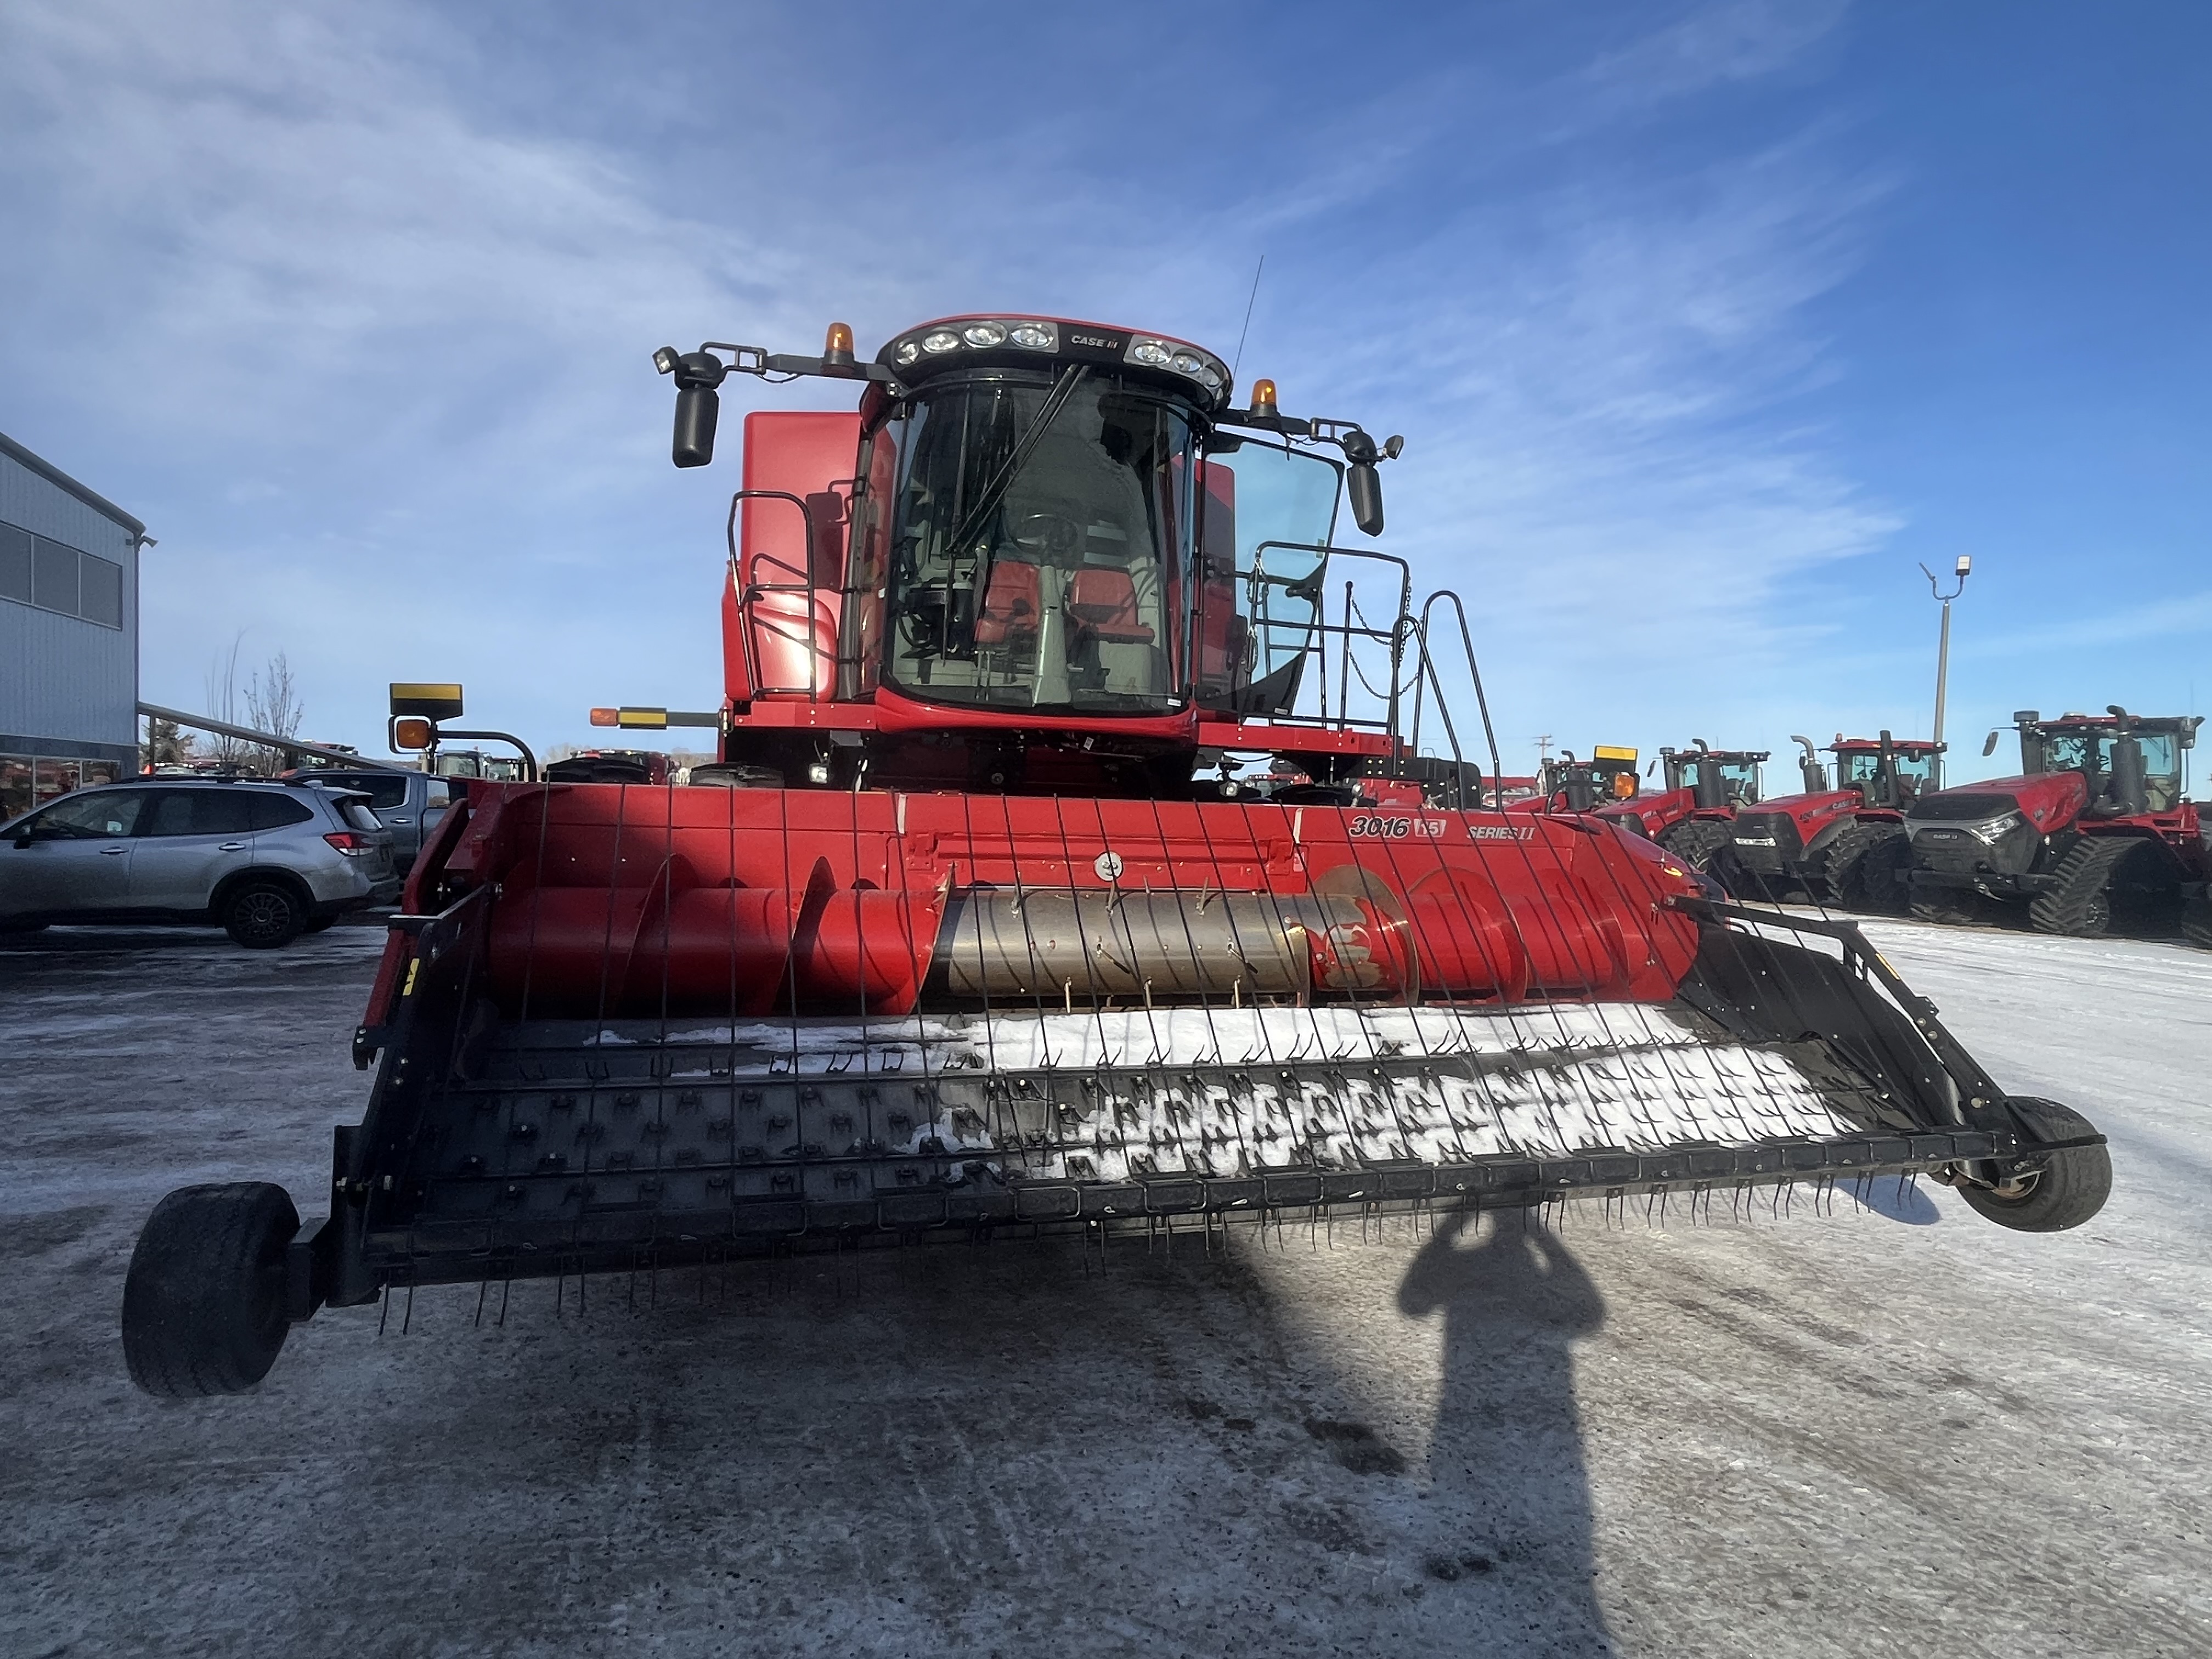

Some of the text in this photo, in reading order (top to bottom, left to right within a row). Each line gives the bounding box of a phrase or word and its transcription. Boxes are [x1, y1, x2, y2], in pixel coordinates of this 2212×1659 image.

[1071, 335, 1104, 347] CASE
[1349, 816, 1536, 840] 3016 15 SERIES II
